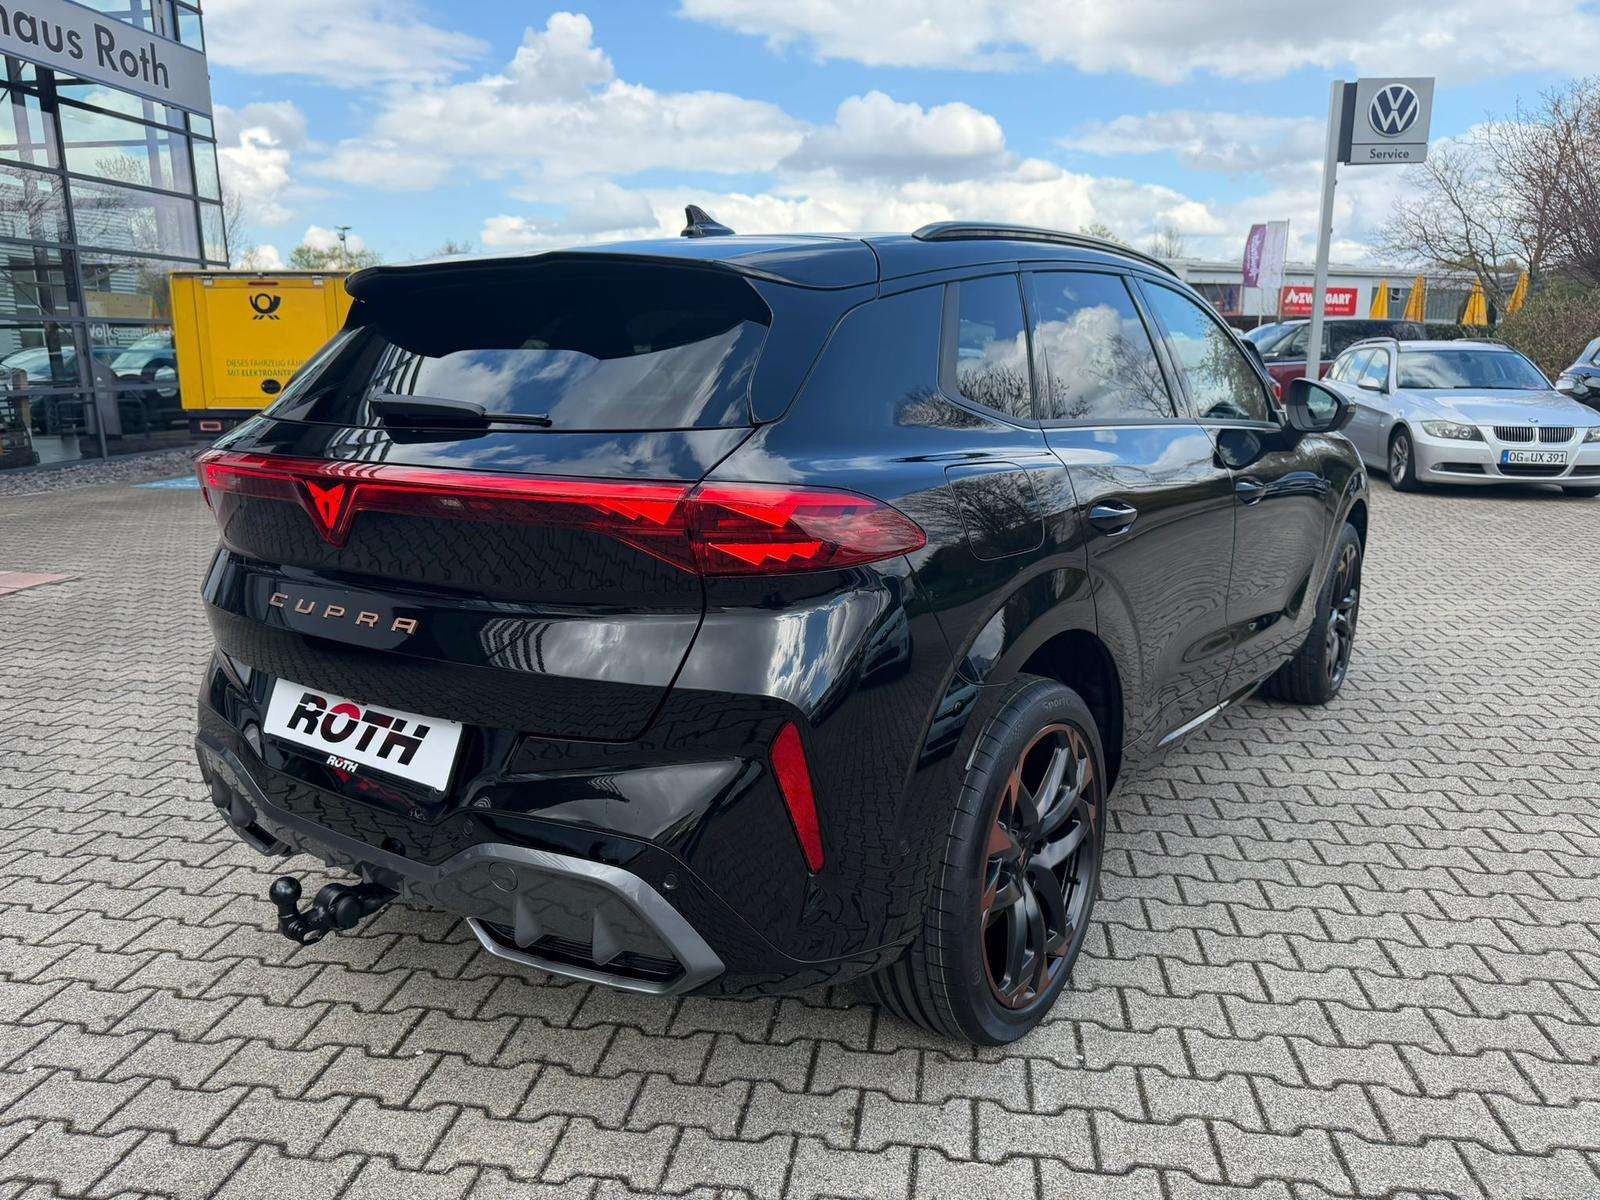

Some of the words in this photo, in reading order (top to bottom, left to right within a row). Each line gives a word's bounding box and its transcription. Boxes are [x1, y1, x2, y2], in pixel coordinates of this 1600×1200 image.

[93, 22, 170, 90] Roth
[1369, 148, 1410, 159] Service
[1298, 292, 1352, 305] ZWGART
[1509, 451, 1524, 462] OG
[1530, 452, 1546, 463] UX
[1546, 453, 1565, 464] 391
[268, 592, 419, 636] CUPRA
[286, 691, 431, 766] ROTH
[326, 754, 359, 773] ROTH
